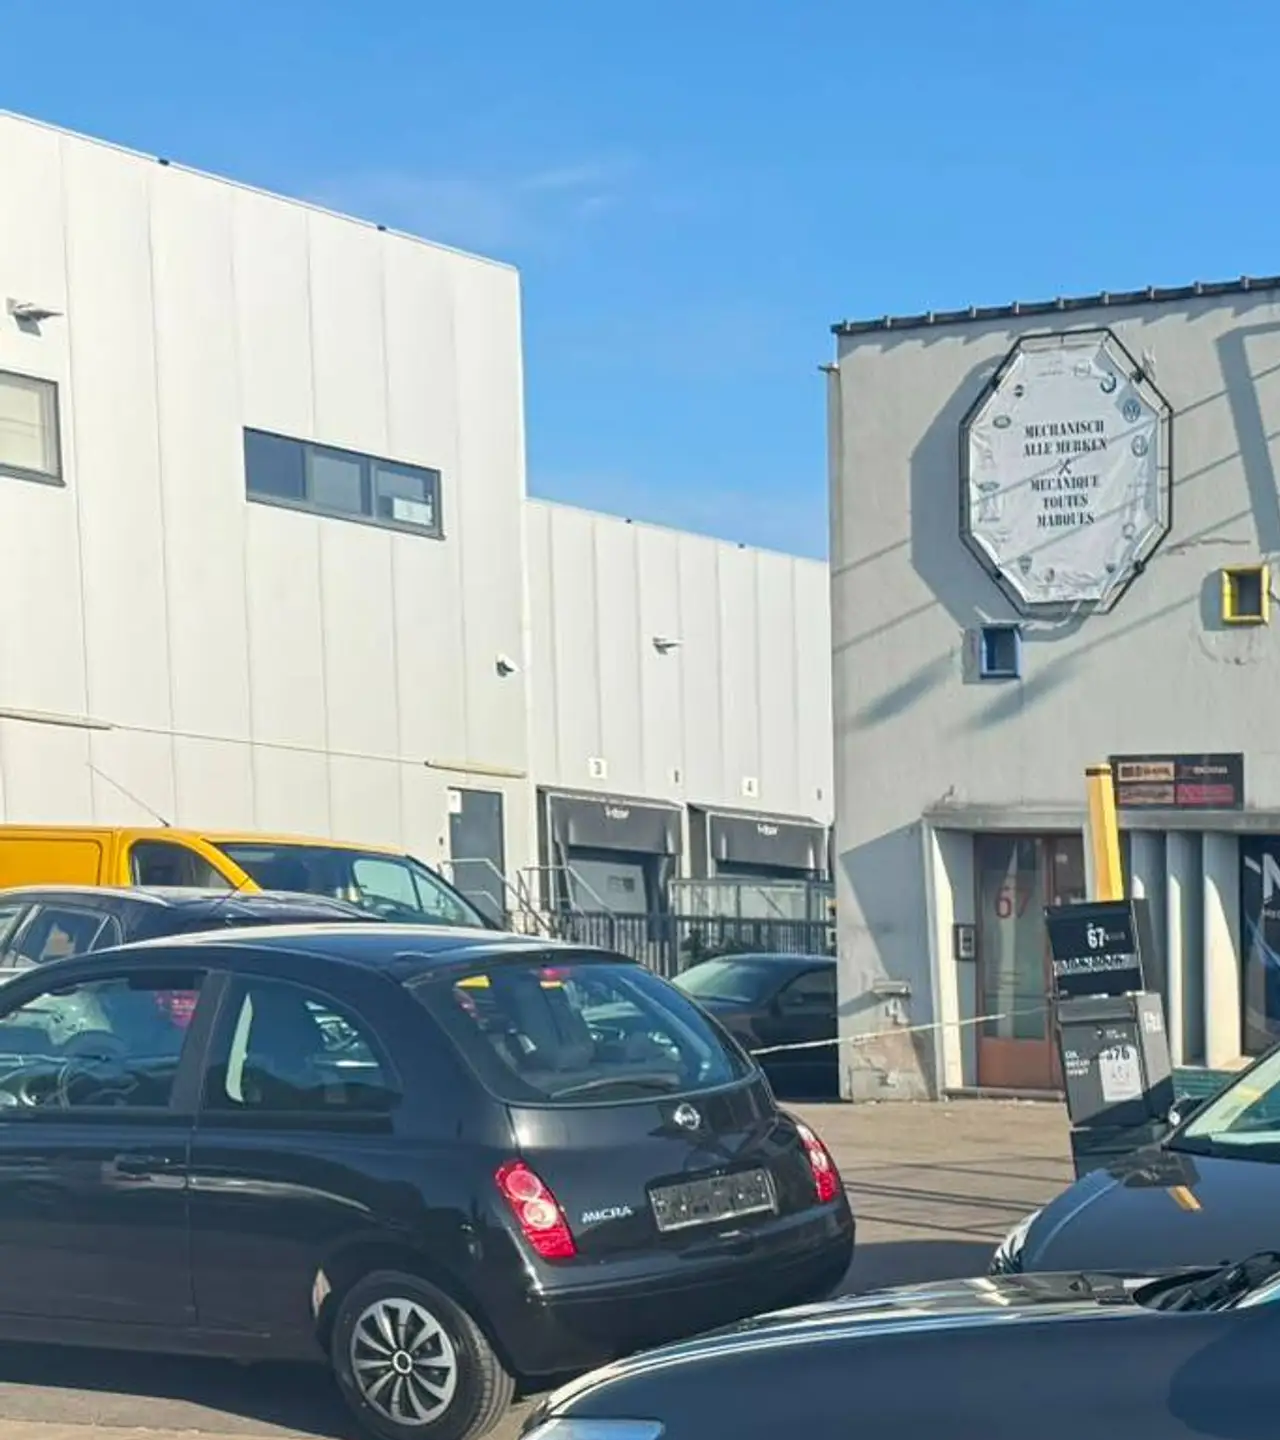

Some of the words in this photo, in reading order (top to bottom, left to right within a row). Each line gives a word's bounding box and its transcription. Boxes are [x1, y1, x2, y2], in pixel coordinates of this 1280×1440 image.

[1025, 420, 1104, 437] MECHANISCH
[1023, 441, 1052, 457] ALLE
[1056, 438, 1107, 455] MERKEN
[1030, 474, 1099, 492] MECANIQUE
[1042, 494, 1089, 510] TOUTES
[1036, 512, 1095, 528] MARQUES
[582, 1205, 632, 1224] MICRA
